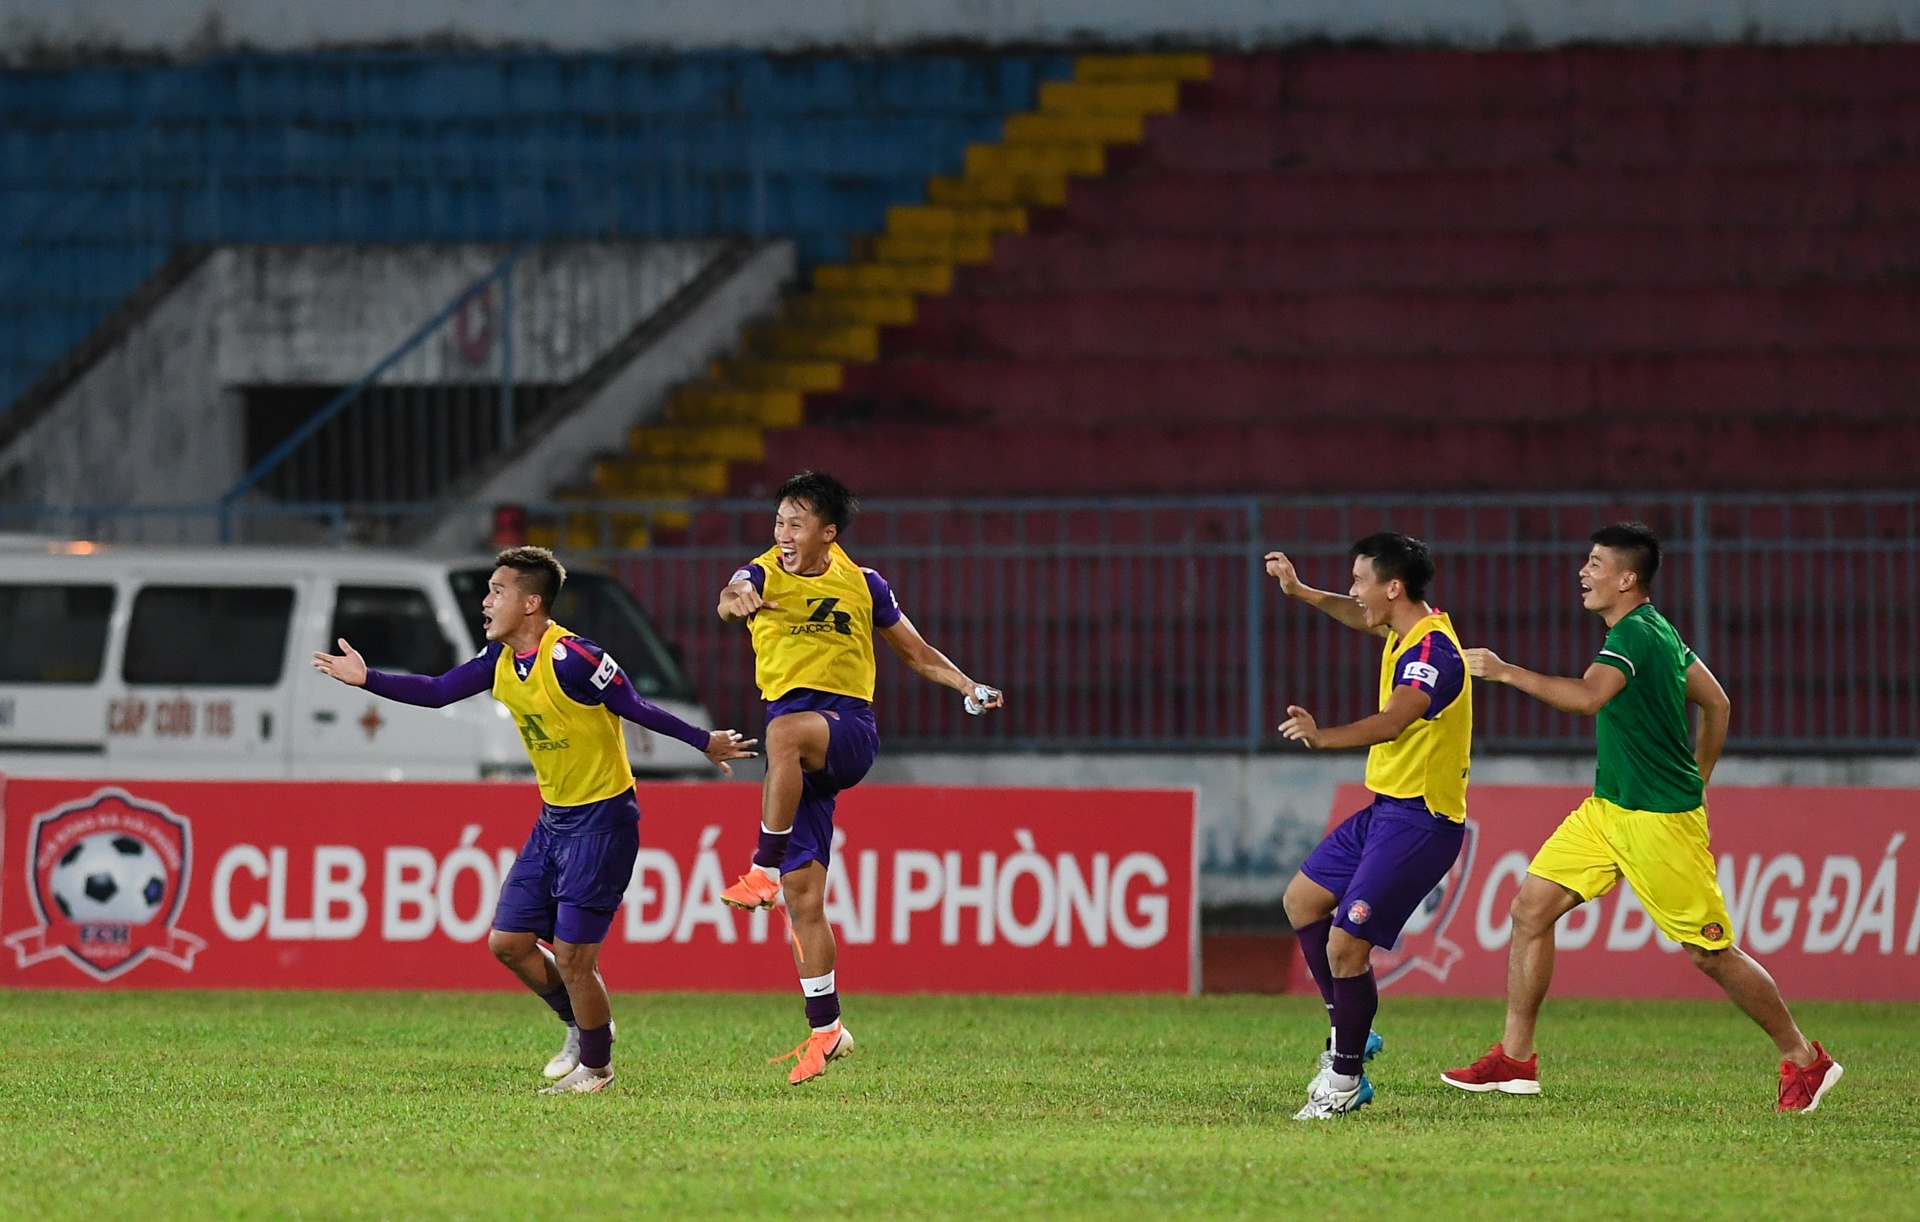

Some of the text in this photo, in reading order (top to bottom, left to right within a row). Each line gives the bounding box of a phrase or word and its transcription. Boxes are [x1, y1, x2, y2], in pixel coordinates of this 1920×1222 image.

[789, 624, 832, 635] ZAICRO
[598, 661, 614, 685] LS
[1407, 665, 1430, 679] LS
[211, 844, 368, 941] CLB
[382, 823, 520, 943] BÓ
[623, 825, 737, 944] ĐÁ
[892, 828, 1169, 949] PHÒNG
[1803, 831, 1906, 955] ĐÁ
